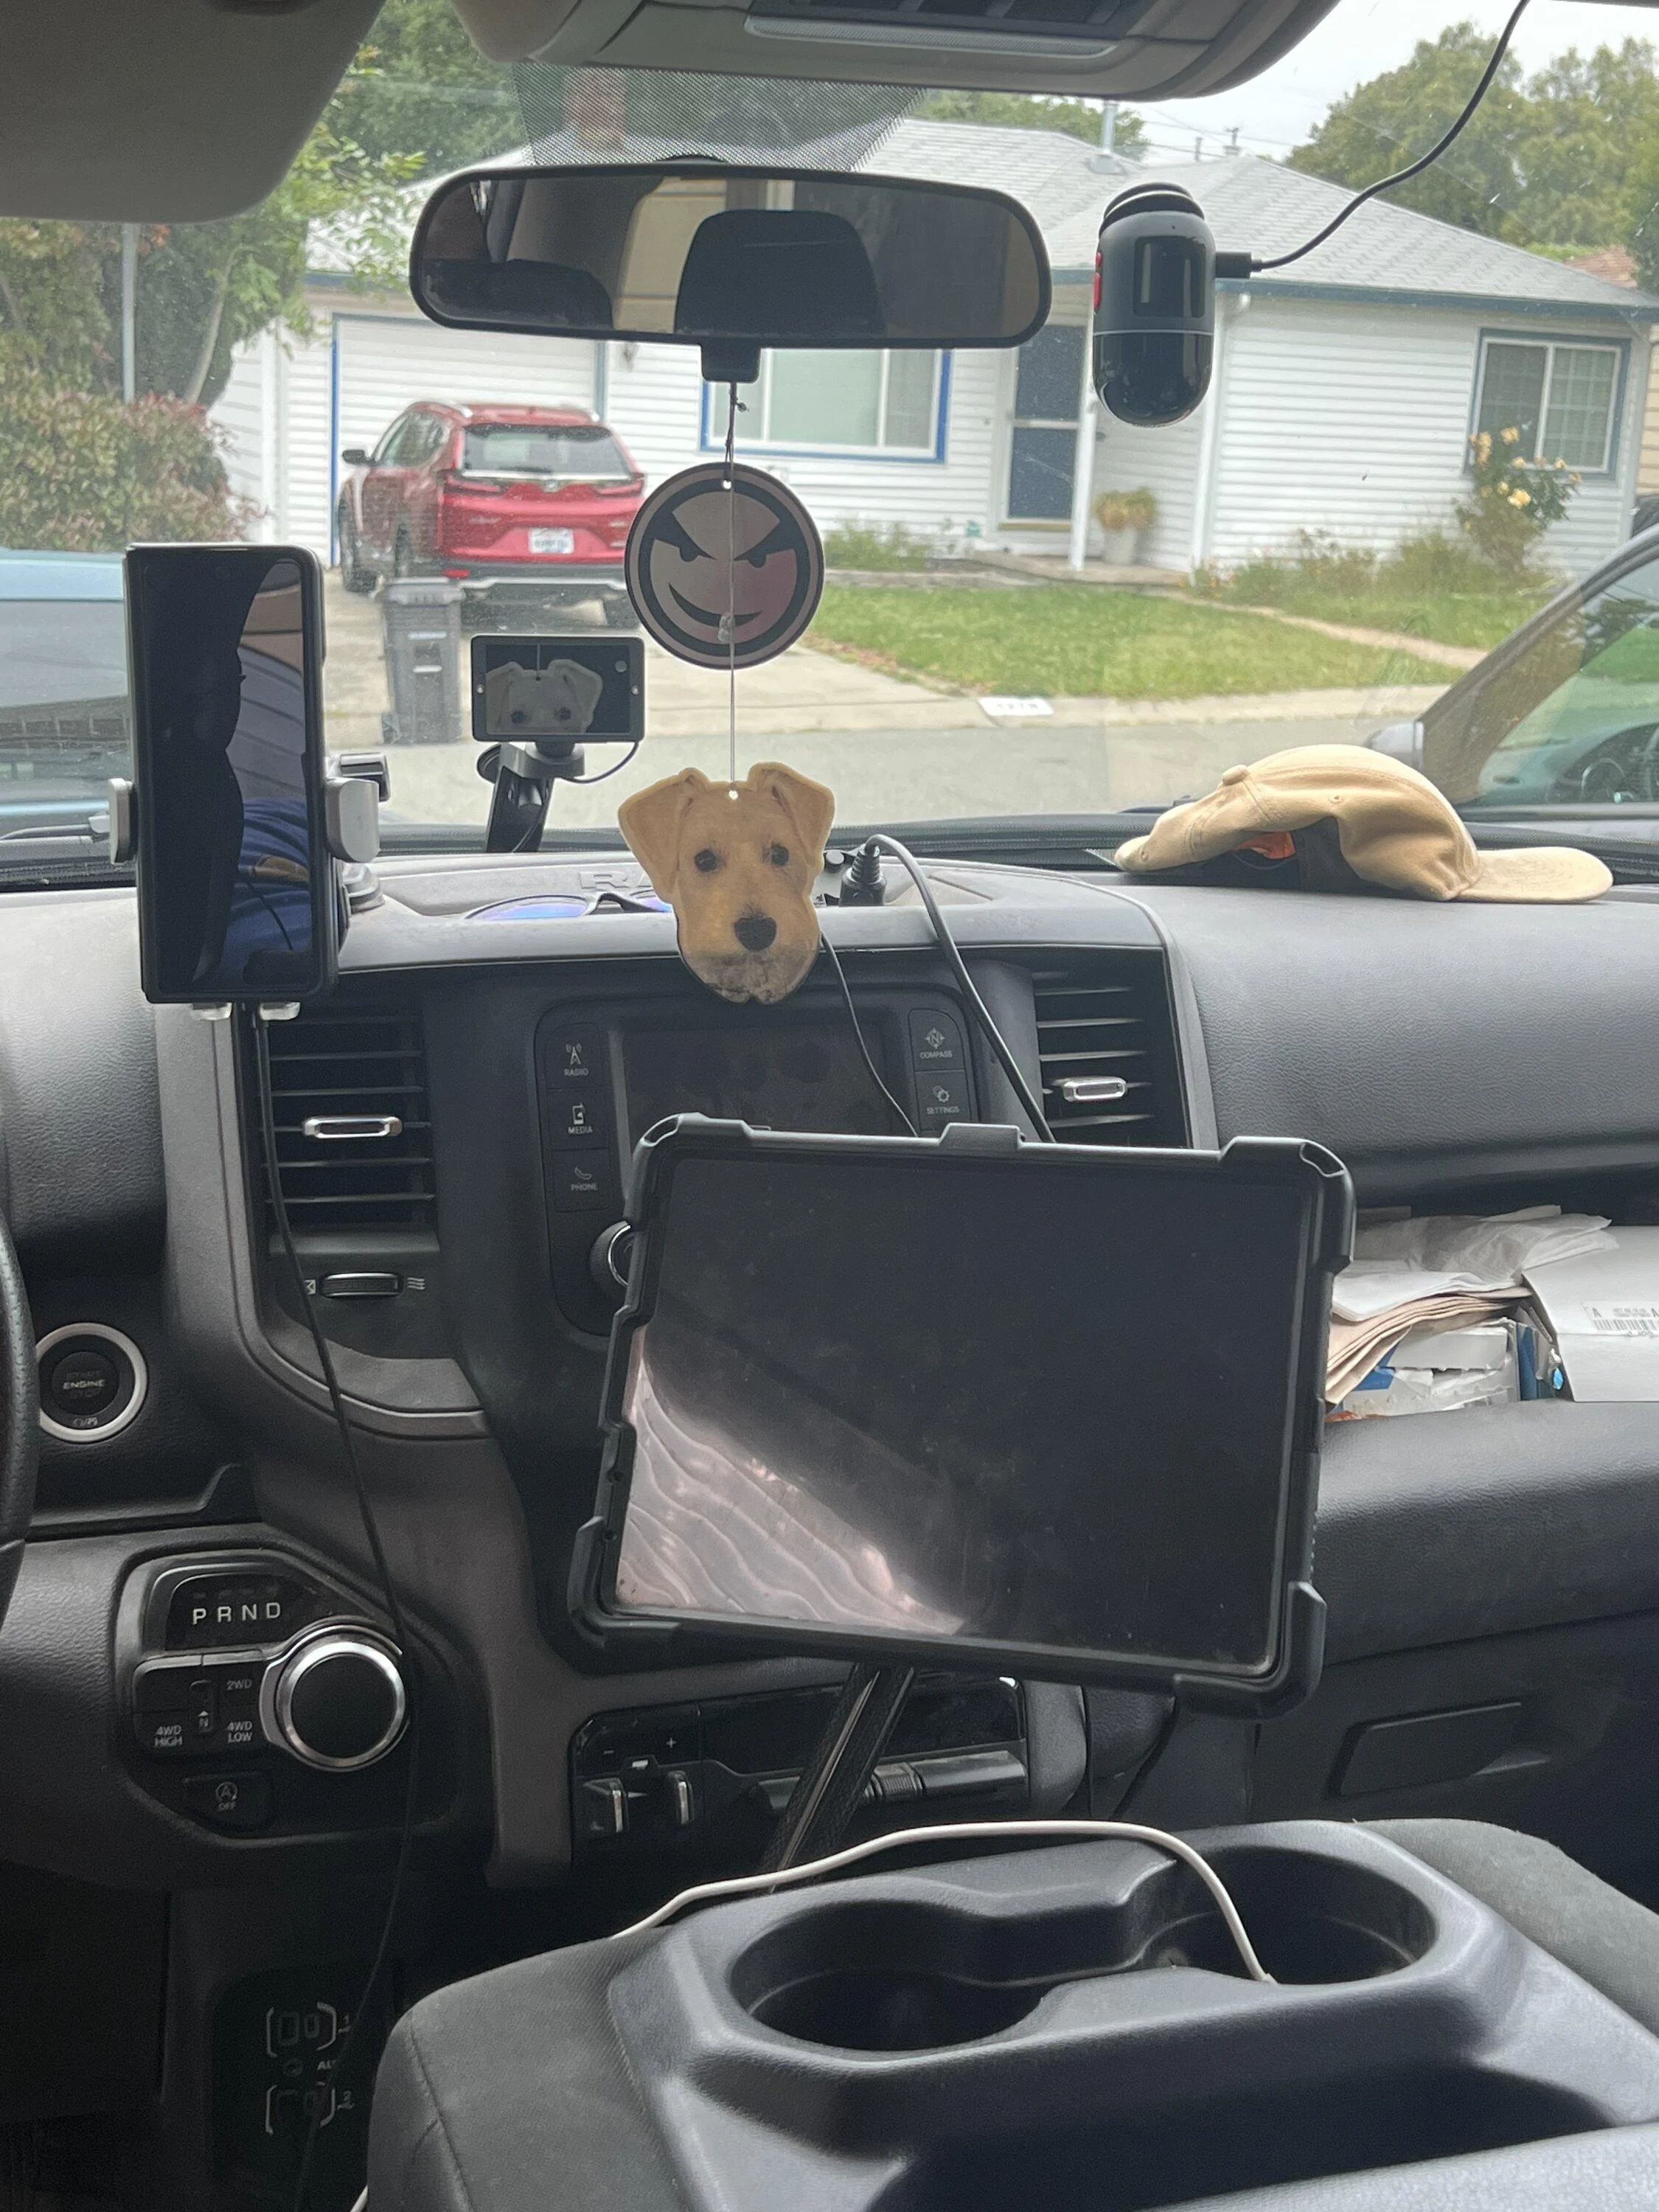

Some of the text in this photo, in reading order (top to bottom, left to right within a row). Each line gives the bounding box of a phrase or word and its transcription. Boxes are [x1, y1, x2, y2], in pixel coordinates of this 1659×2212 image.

[919, 1050, 953, 1060] COMPASS
[564, 1067, 588, 1076] RADIO
[926, 1106, 960, 1116] SETTINGS
[568, 1125, 593, 1135] MEDIA
[571, 1182, 598, 1192] PHONE
[63, 1379, 105, 1390] ENGINE
[192, 1602, 281, 1625] P R N D
[226, 1678, 252, 1690] 2WD
[156, 1724, 182, 1736] 4WD
[227, 1720, 253, 1732] 4WD
[153, 1735, 183, 1747] HIGH
[227, 1732, 253, 1744] LOW
[218, 1801, 237, 1811] OFF
